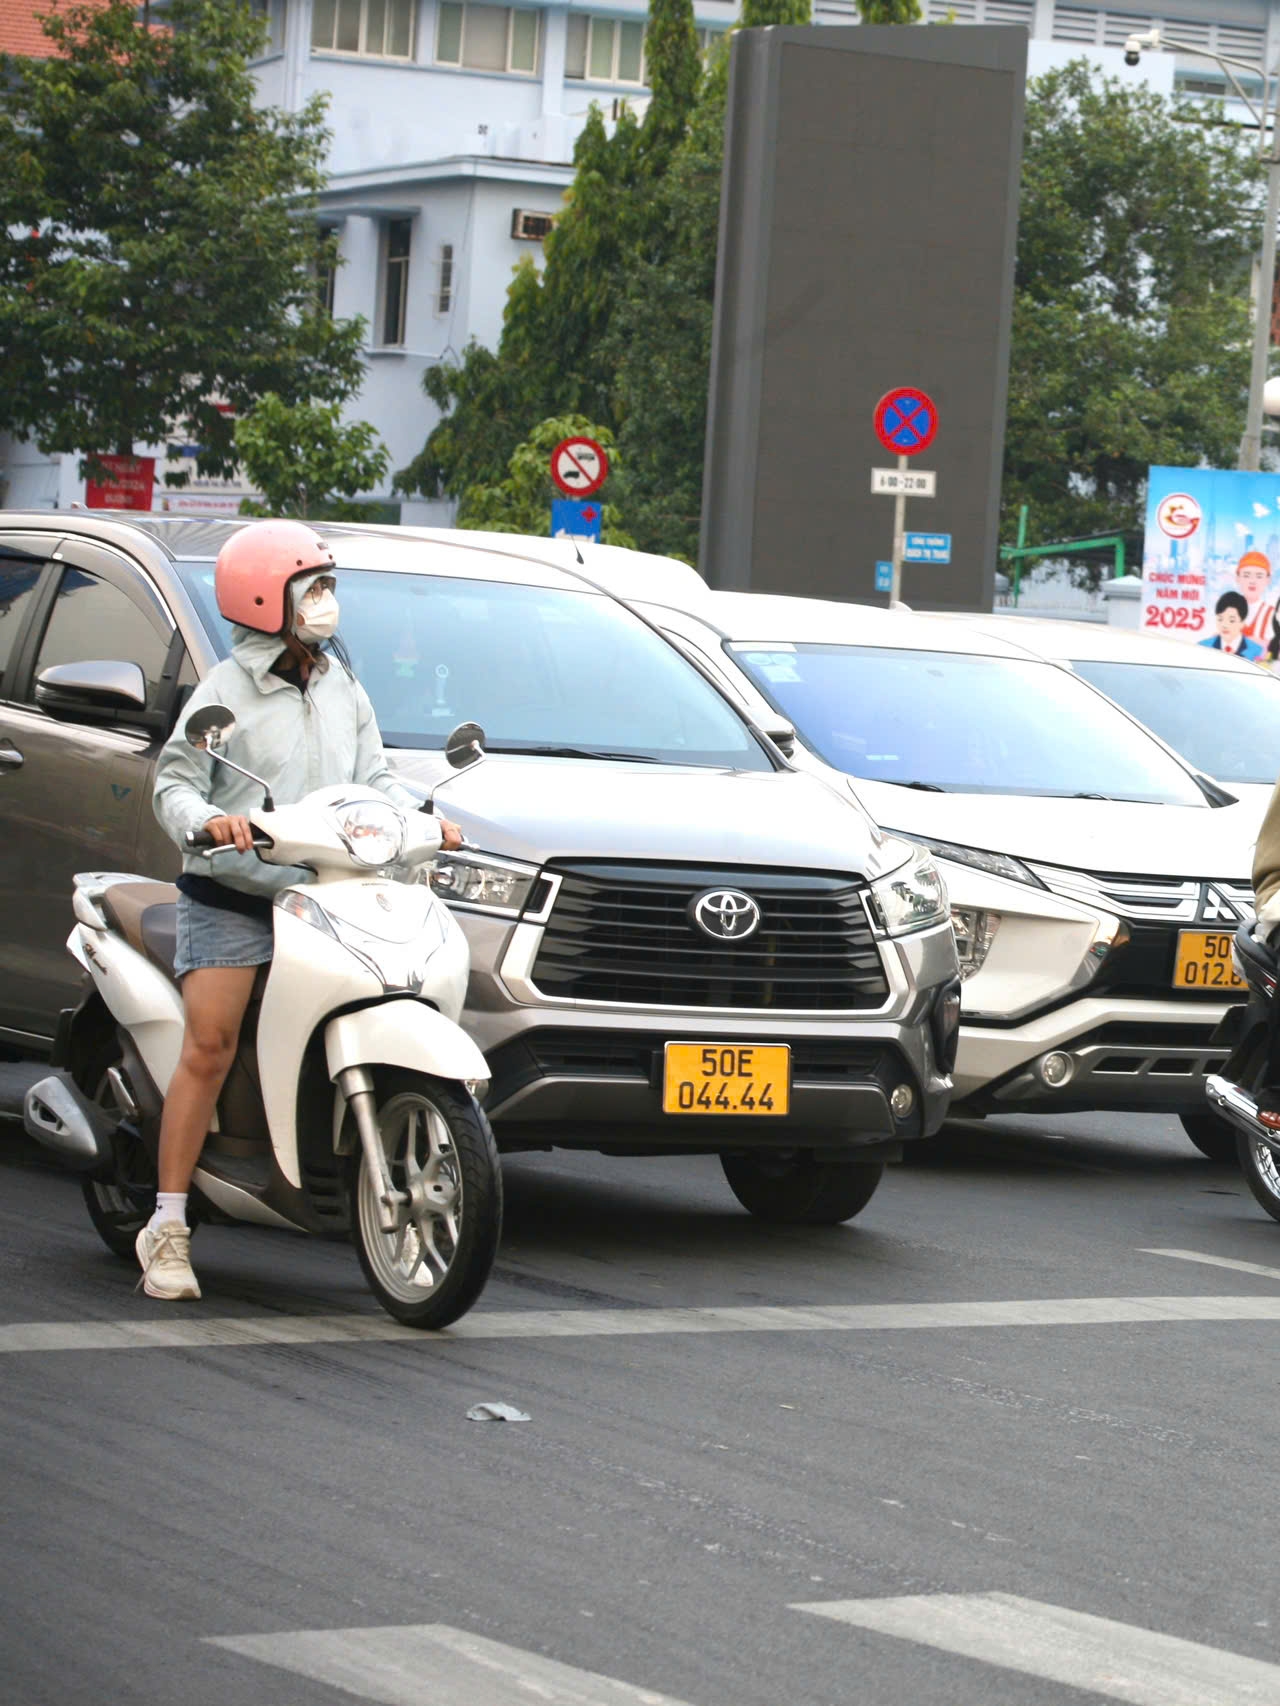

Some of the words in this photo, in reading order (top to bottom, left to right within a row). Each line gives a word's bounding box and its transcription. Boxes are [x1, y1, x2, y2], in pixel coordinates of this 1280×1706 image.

[1146, 604, 1206, 631] 2025
[701, 1048, 754, 1078] 50E
[678, 1081, 774, 1111] 044.44
